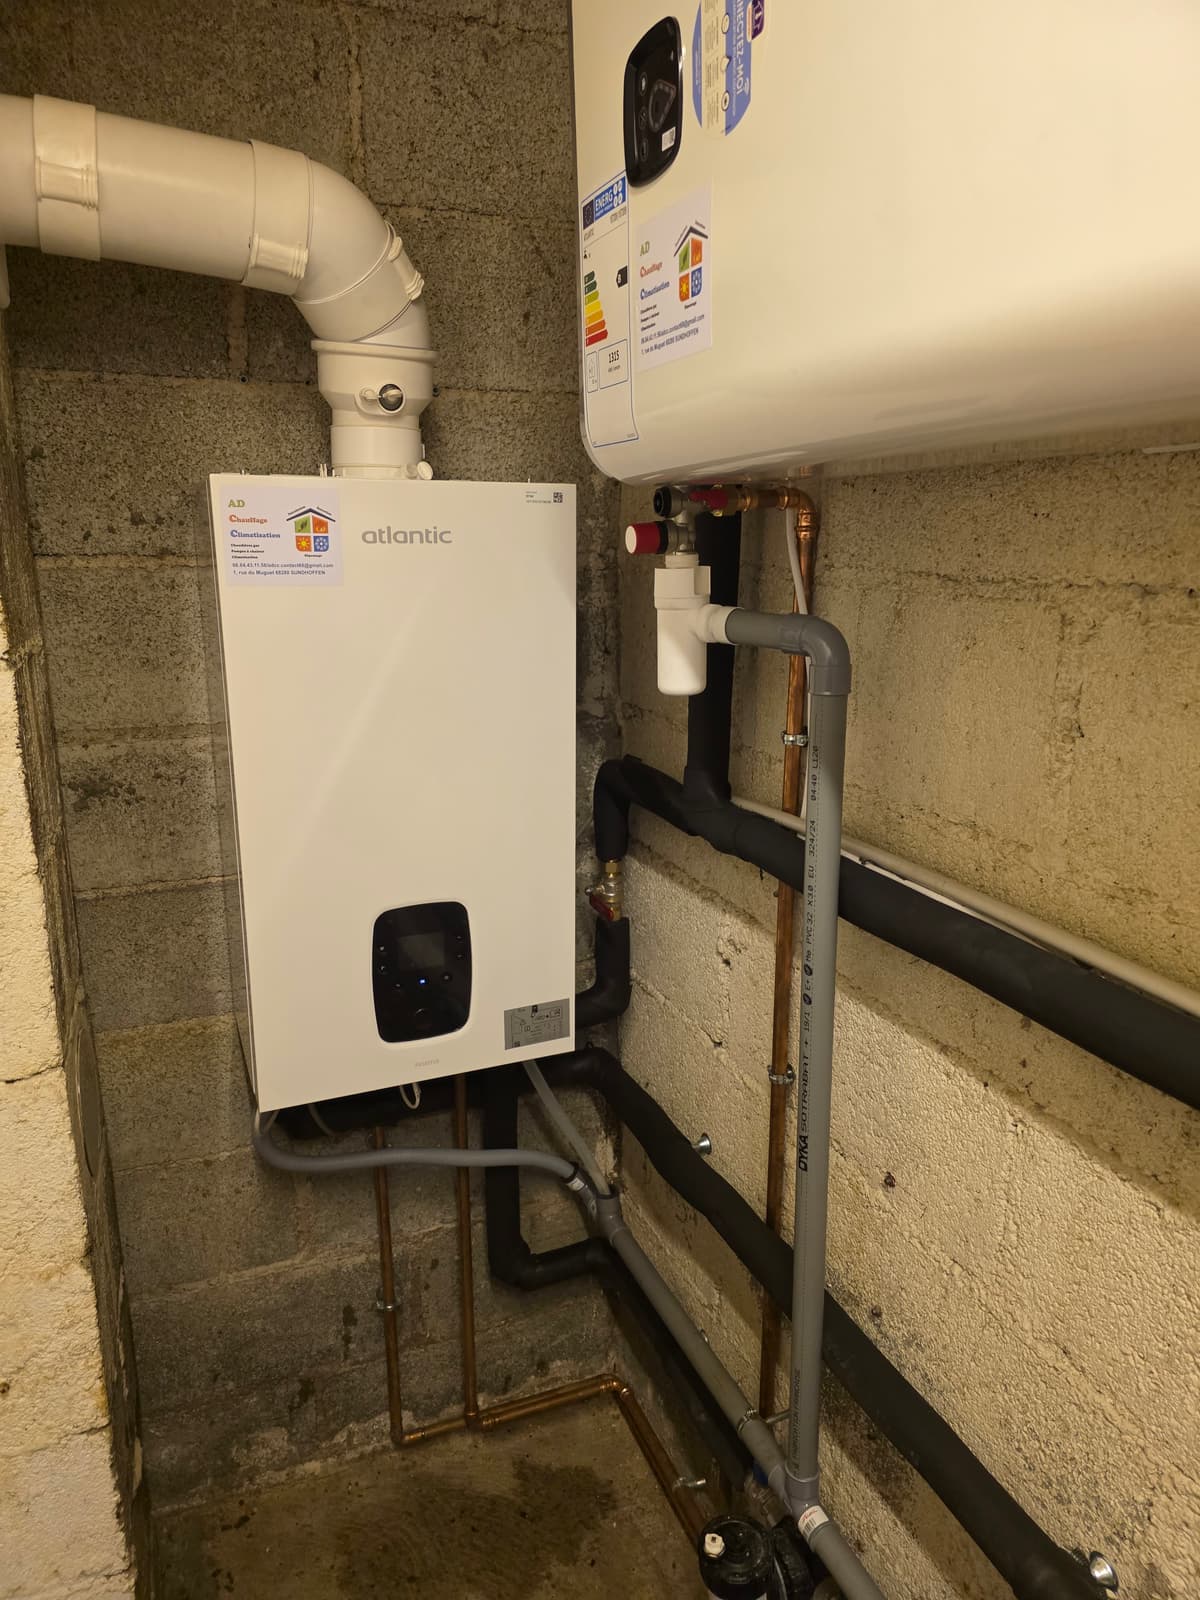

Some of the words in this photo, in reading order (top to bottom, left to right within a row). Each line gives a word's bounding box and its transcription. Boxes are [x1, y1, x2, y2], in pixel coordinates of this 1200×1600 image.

[596, 189, 613, 211] ENERG
[640, 241, 650, 256] AD
[228, 499, 246, 508] AD
[229, 514, 268, 524] Chauffage
[230, 529, 281, 539] Climatisation
[361, 525, 453, 545] atlantic
[798, 1135, 809, 1172] DYKA
